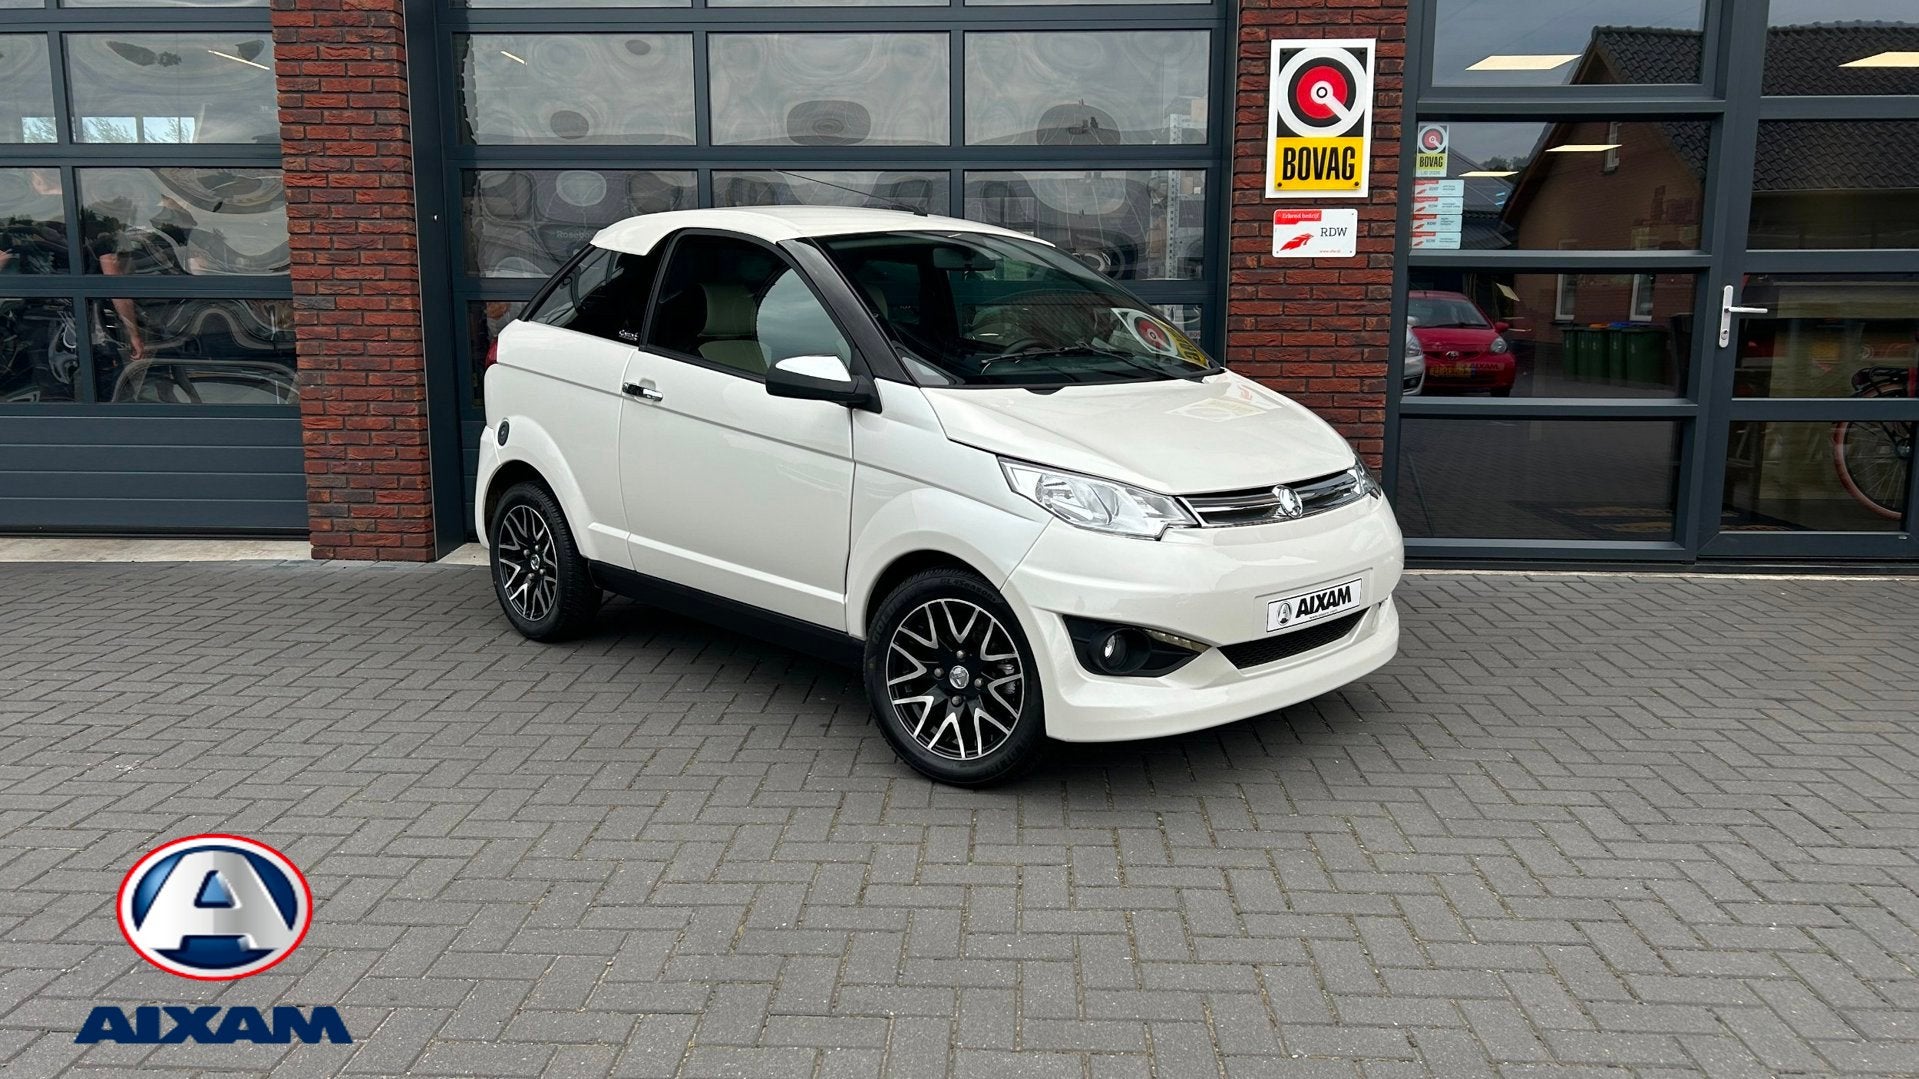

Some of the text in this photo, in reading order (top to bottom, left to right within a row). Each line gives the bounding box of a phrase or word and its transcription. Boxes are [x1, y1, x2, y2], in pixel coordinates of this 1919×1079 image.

[1282, 146, 1356, 181] BOVAG
[1419, 156, 1443, 168] BOVAG
[1320, 227, 1347, 237] RDW
[1295, 585, 1352, 618] AIXAM
